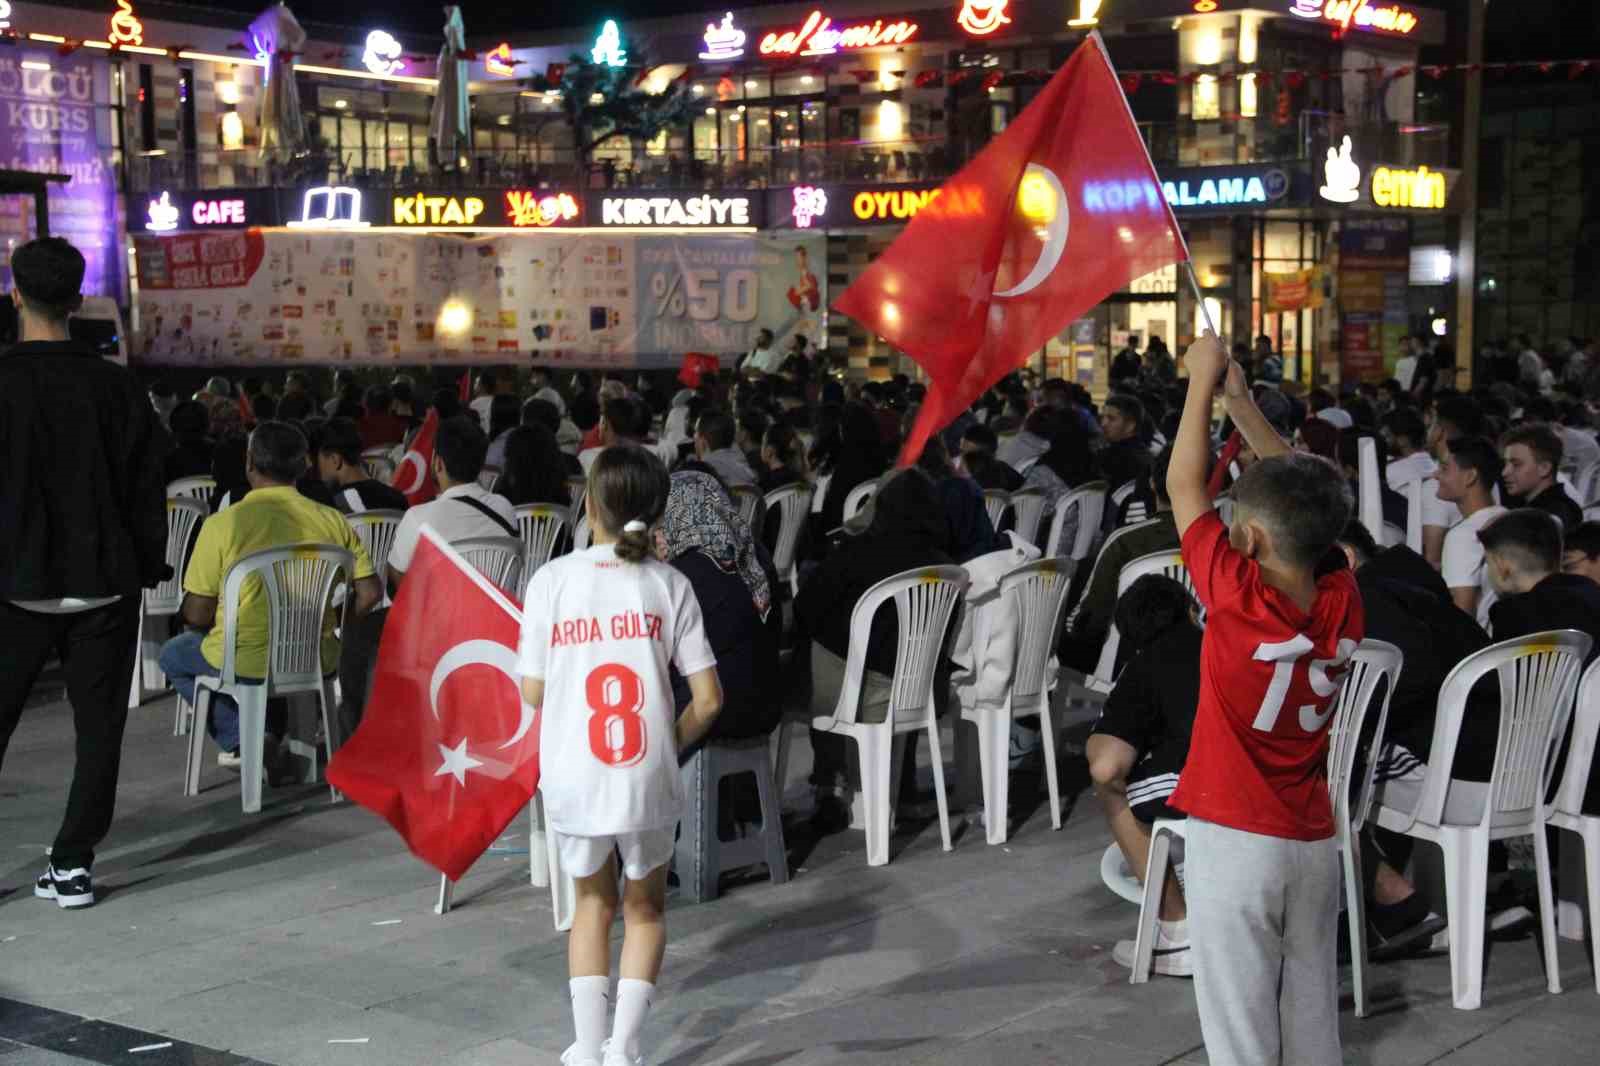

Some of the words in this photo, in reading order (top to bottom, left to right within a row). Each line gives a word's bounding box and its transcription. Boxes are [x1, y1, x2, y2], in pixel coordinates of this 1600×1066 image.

[8, 101, 89, 133] KURS
[852, 187, 985, 221] OYUNCAK
[1082, 175, 1267, 214] KOPYALAMA
[1372, 165, 1446, 208] emin
[192, 200, 246, 224] CAFE
[393, 193, 485, 224] KİTAP
[601, 194, 749, 225] KIRTASİYE
[652, 270, 760, 322] %50
[551, 618, 602, 648] ARDA
[611, 611, 662, 642] GÜLER
[585, 663, 647, 768] 8
